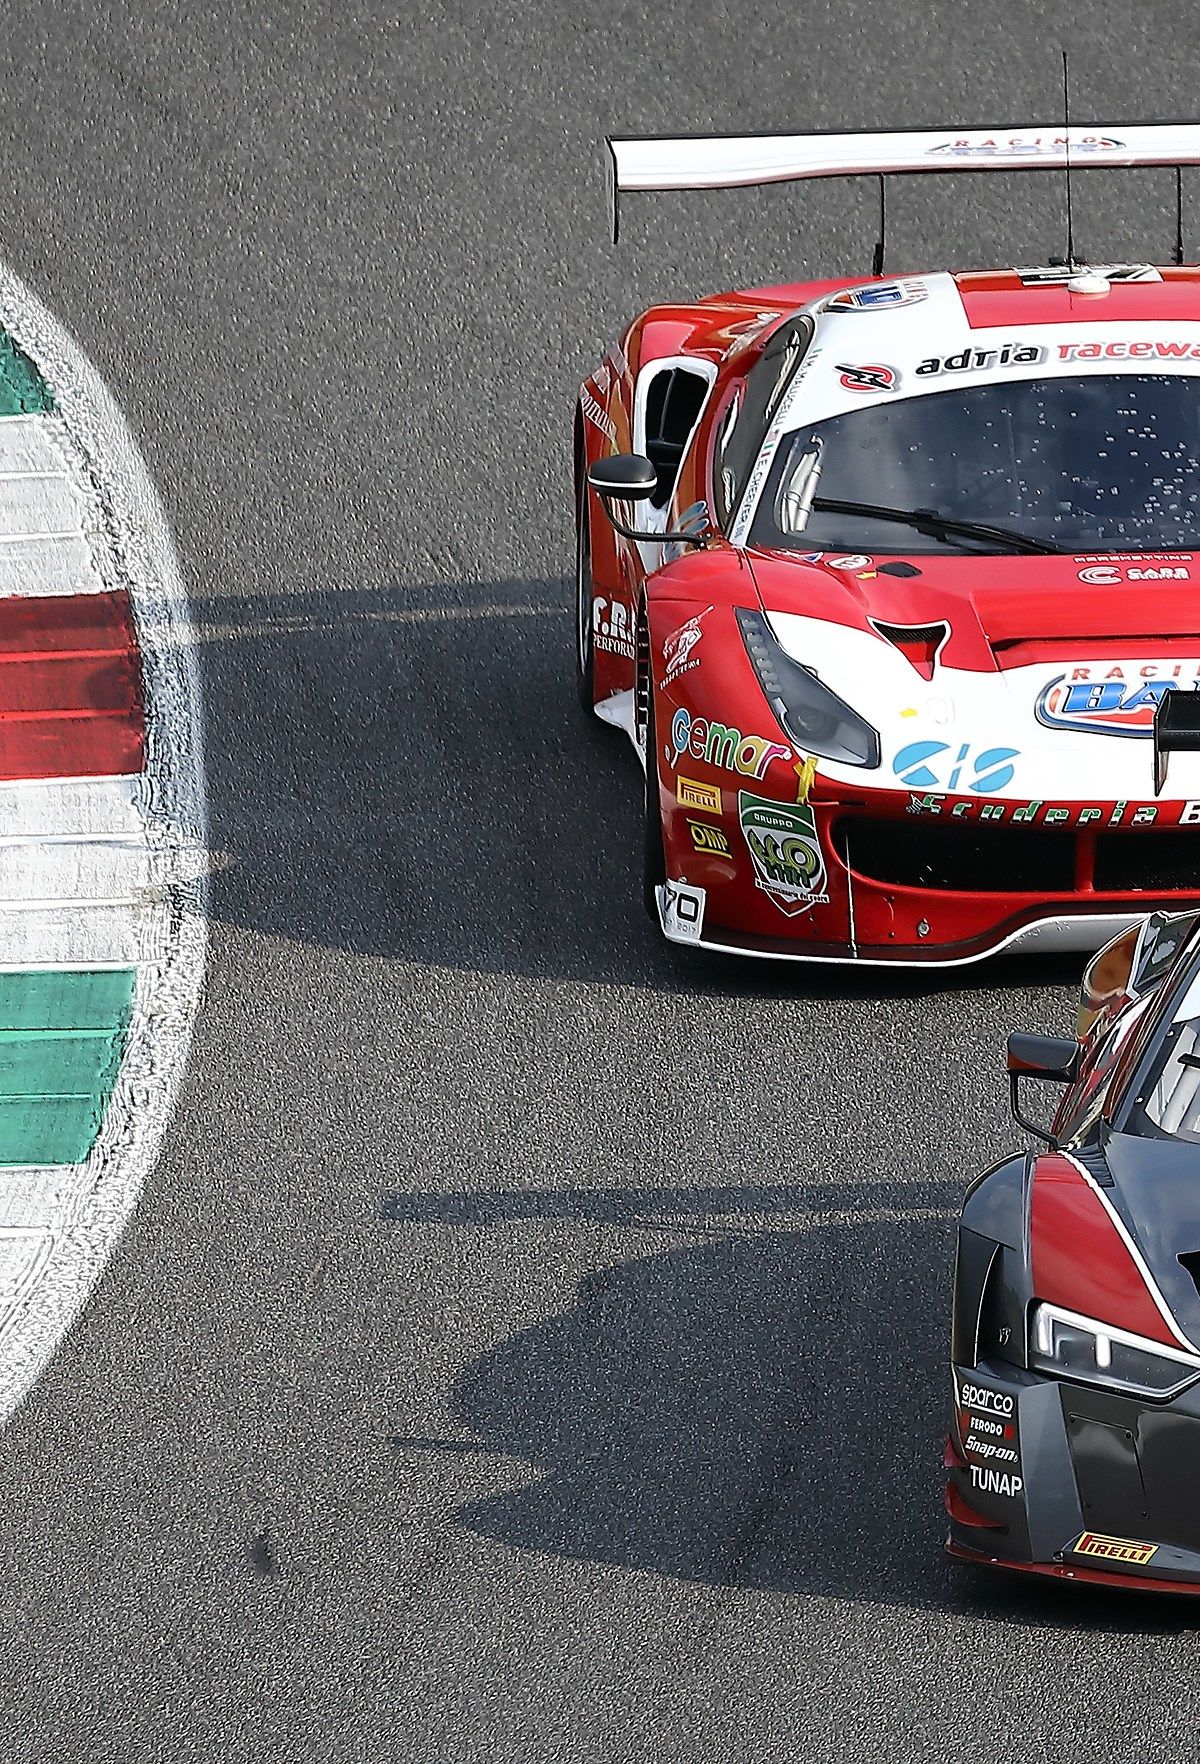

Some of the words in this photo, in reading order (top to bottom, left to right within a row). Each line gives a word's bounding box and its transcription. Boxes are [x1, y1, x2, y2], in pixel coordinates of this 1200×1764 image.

[915, 343, 1040, 375] adria
[681, 784, 718, 809] PIRELLI
[920, 794, 1158, 828] Scuderia
[753, 812, 794, 829] GRUPPO
[691, 823, 729, 852] OMP
[962, 1383, 1014, 1413] sparco
[970, 1416, 1003, 1436] FERODO
[965, 1434, 1015, 1463] Snap-on
[970, 1464, 1023, 1497] TUNAP
[1078, 1534, 1153, 1560] PIRELLI
